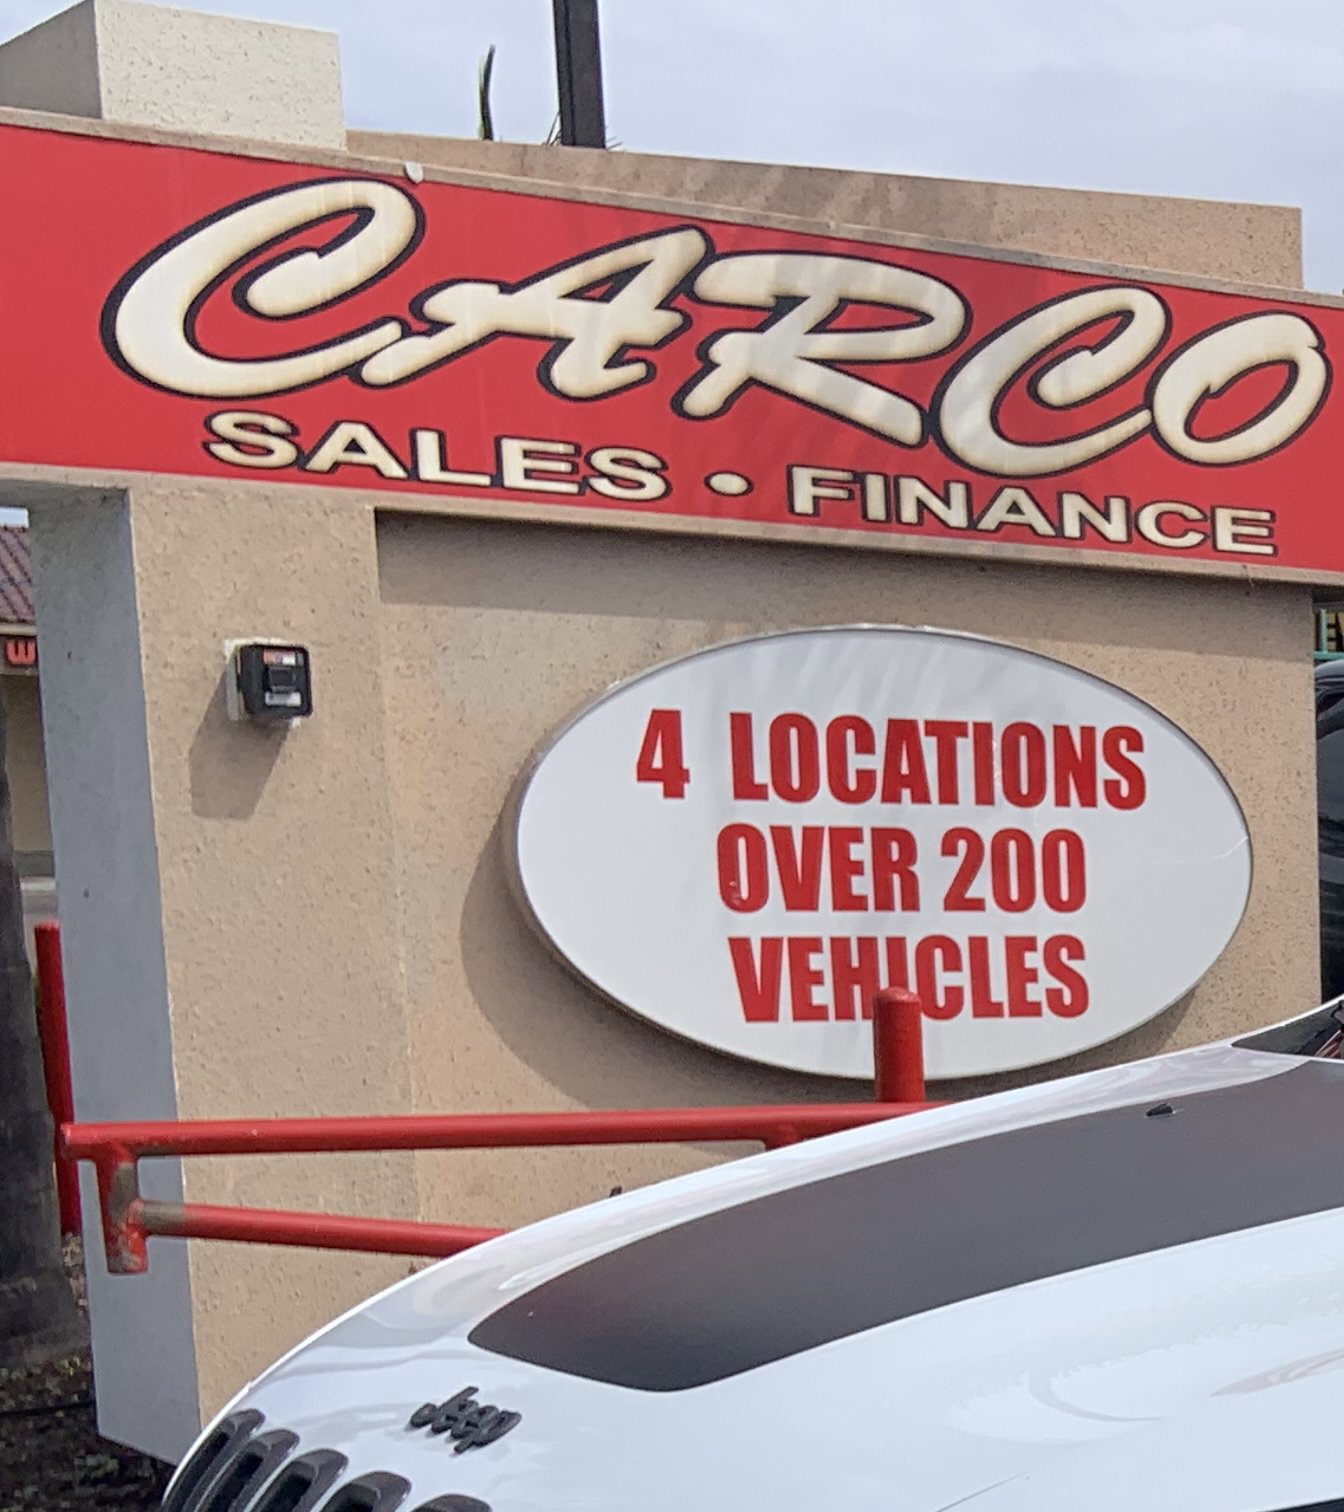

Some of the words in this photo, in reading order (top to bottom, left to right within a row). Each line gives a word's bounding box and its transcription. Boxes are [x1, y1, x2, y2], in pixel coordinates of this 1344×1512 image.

[104, 178, 1332, 476] CARCO
[206, 410, 668, 503] SALES
[792, 466, 1278, 557] FINANCE
[636, 709, 690, 800] 4
[729, 712, 1147, 811] LOCATIONS
[717, 823, 920, 914] OVER
[940, 827, 1086, 914] 200
[727, 934, 1090, 1023] VEHICLES
